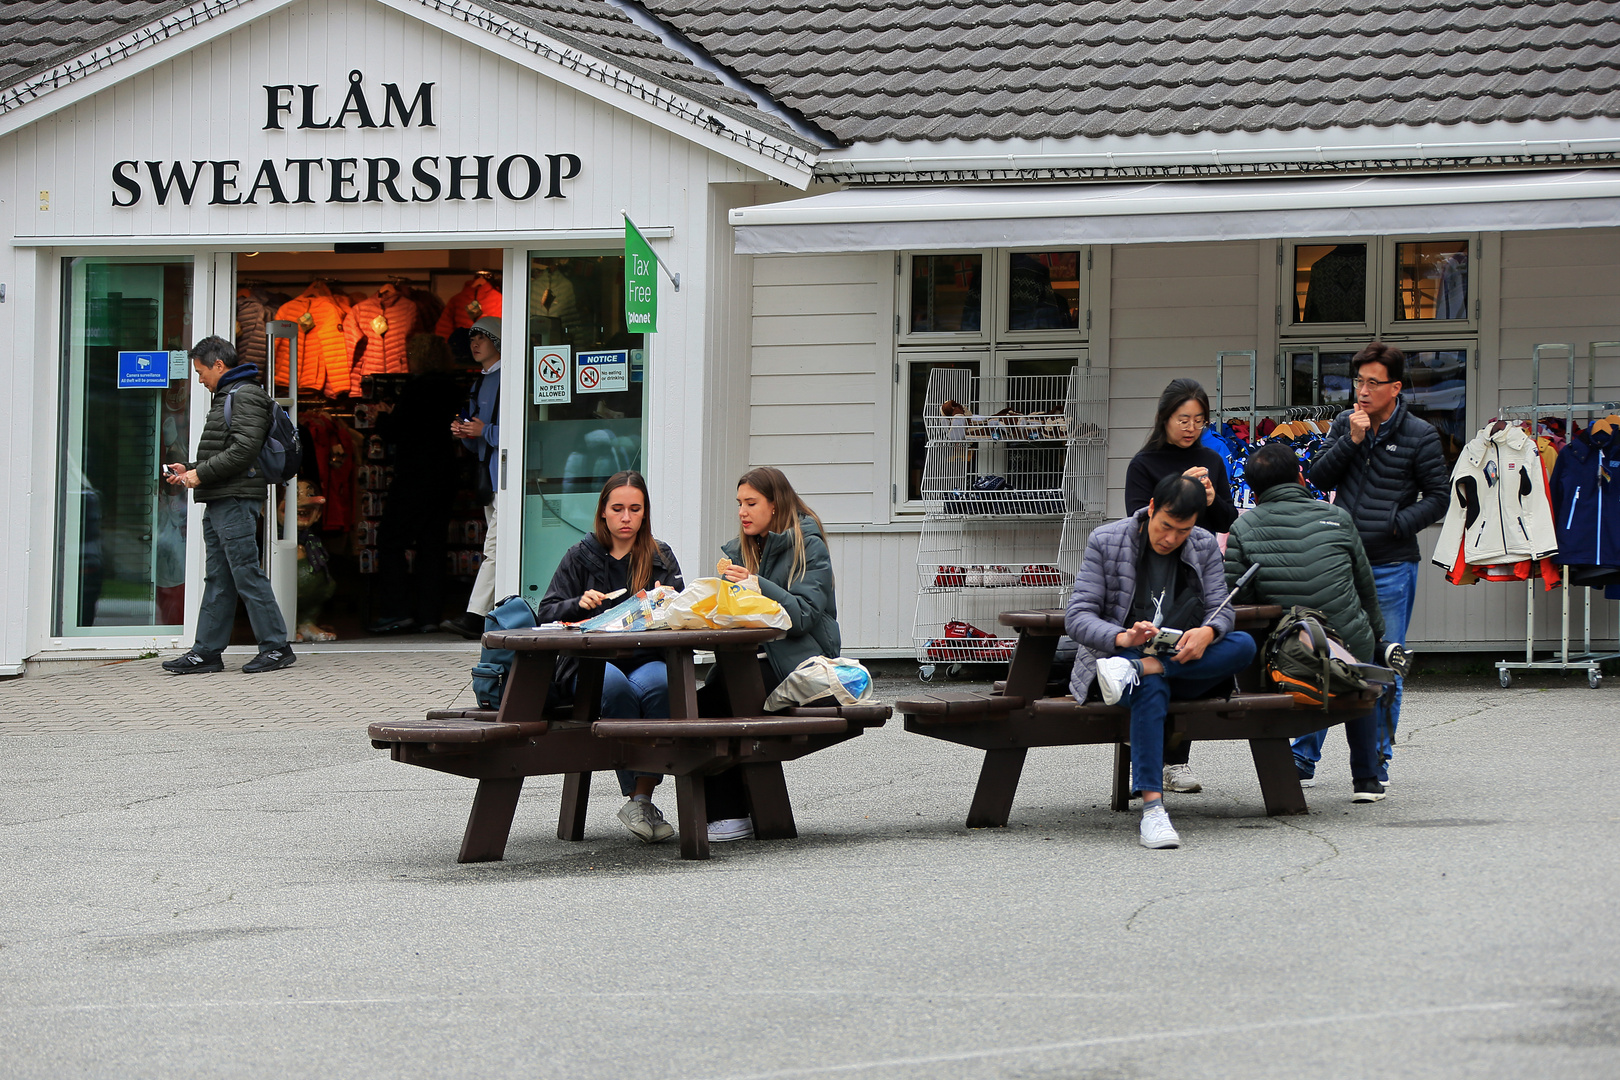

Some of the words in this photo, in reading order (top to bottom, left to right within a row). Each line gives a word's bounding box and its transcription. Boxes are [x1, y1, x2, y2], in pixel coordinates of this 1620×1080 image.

[262, 69, 436, 131] FLÅM
[111, 153, 582, 207] SWEATERSHOP
[632, 253, 650, 276] Tax
[629, 280, 651, 303] Free
[628, 311, 651, 325] planet
[587, 355, 618, 364] NOTICE
[538, 390, 566, 398] ALLOWED
